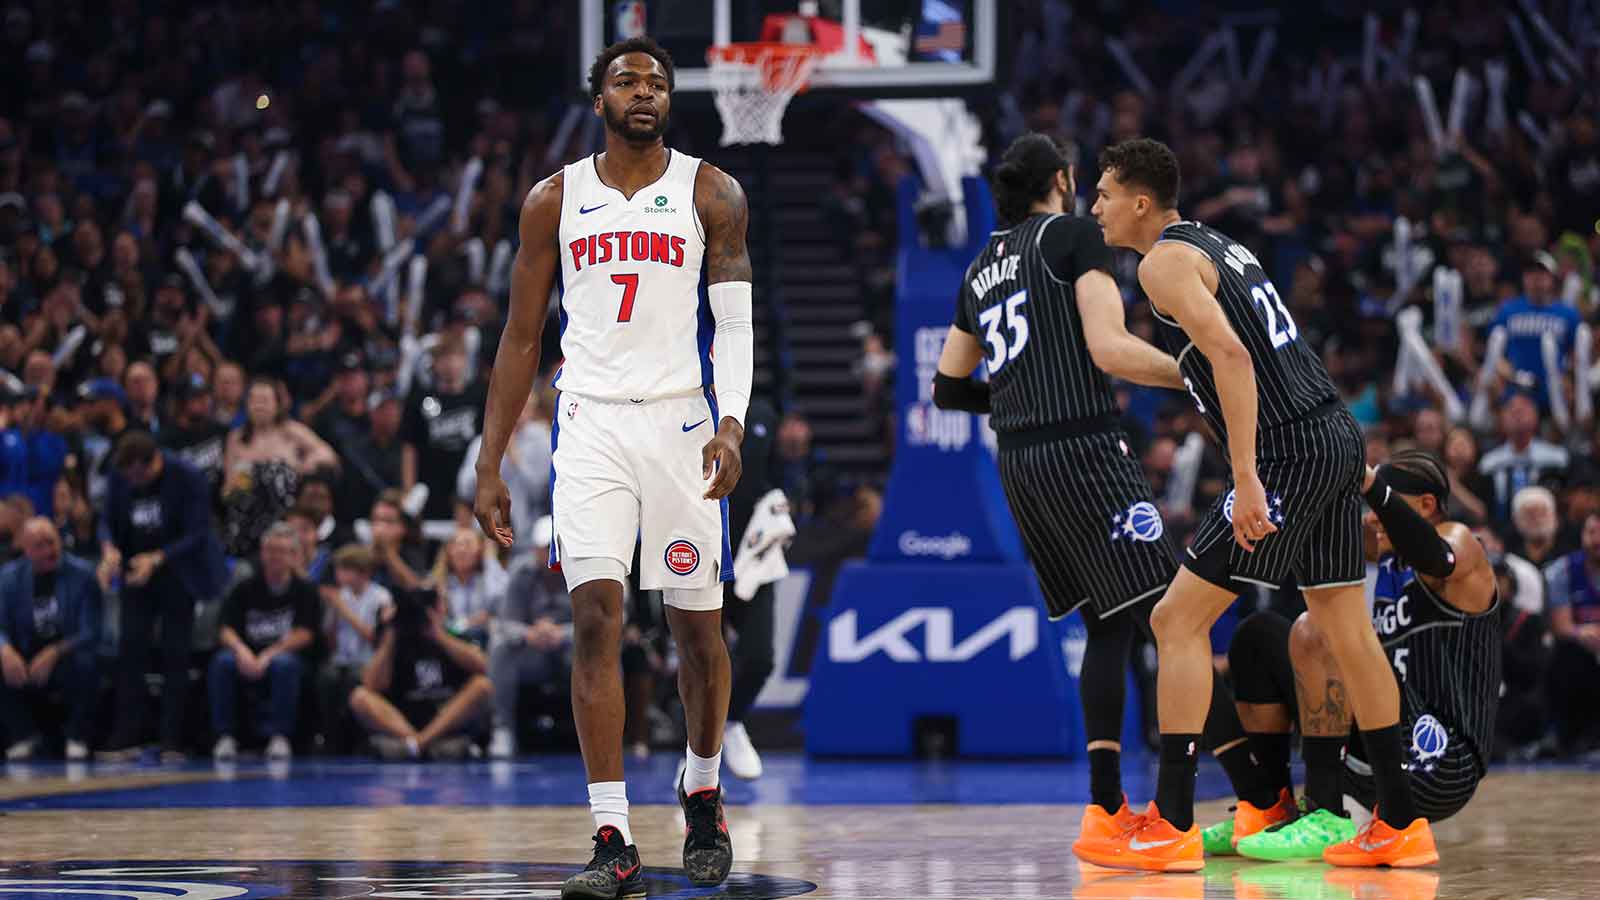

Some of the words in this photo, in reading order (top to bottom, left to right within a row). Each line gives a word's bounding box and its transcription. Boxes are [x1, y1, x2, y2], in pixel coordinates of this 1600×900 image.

[569, 231, 686, 272] PISTONS
[610, 273, 639, 322] 7
[1251, 281, 1297, 348] 23
[979, 289, 1029, 374] 35
[899, 530, 971, 559] Google
[828, 606, 1038, 662] KIA
